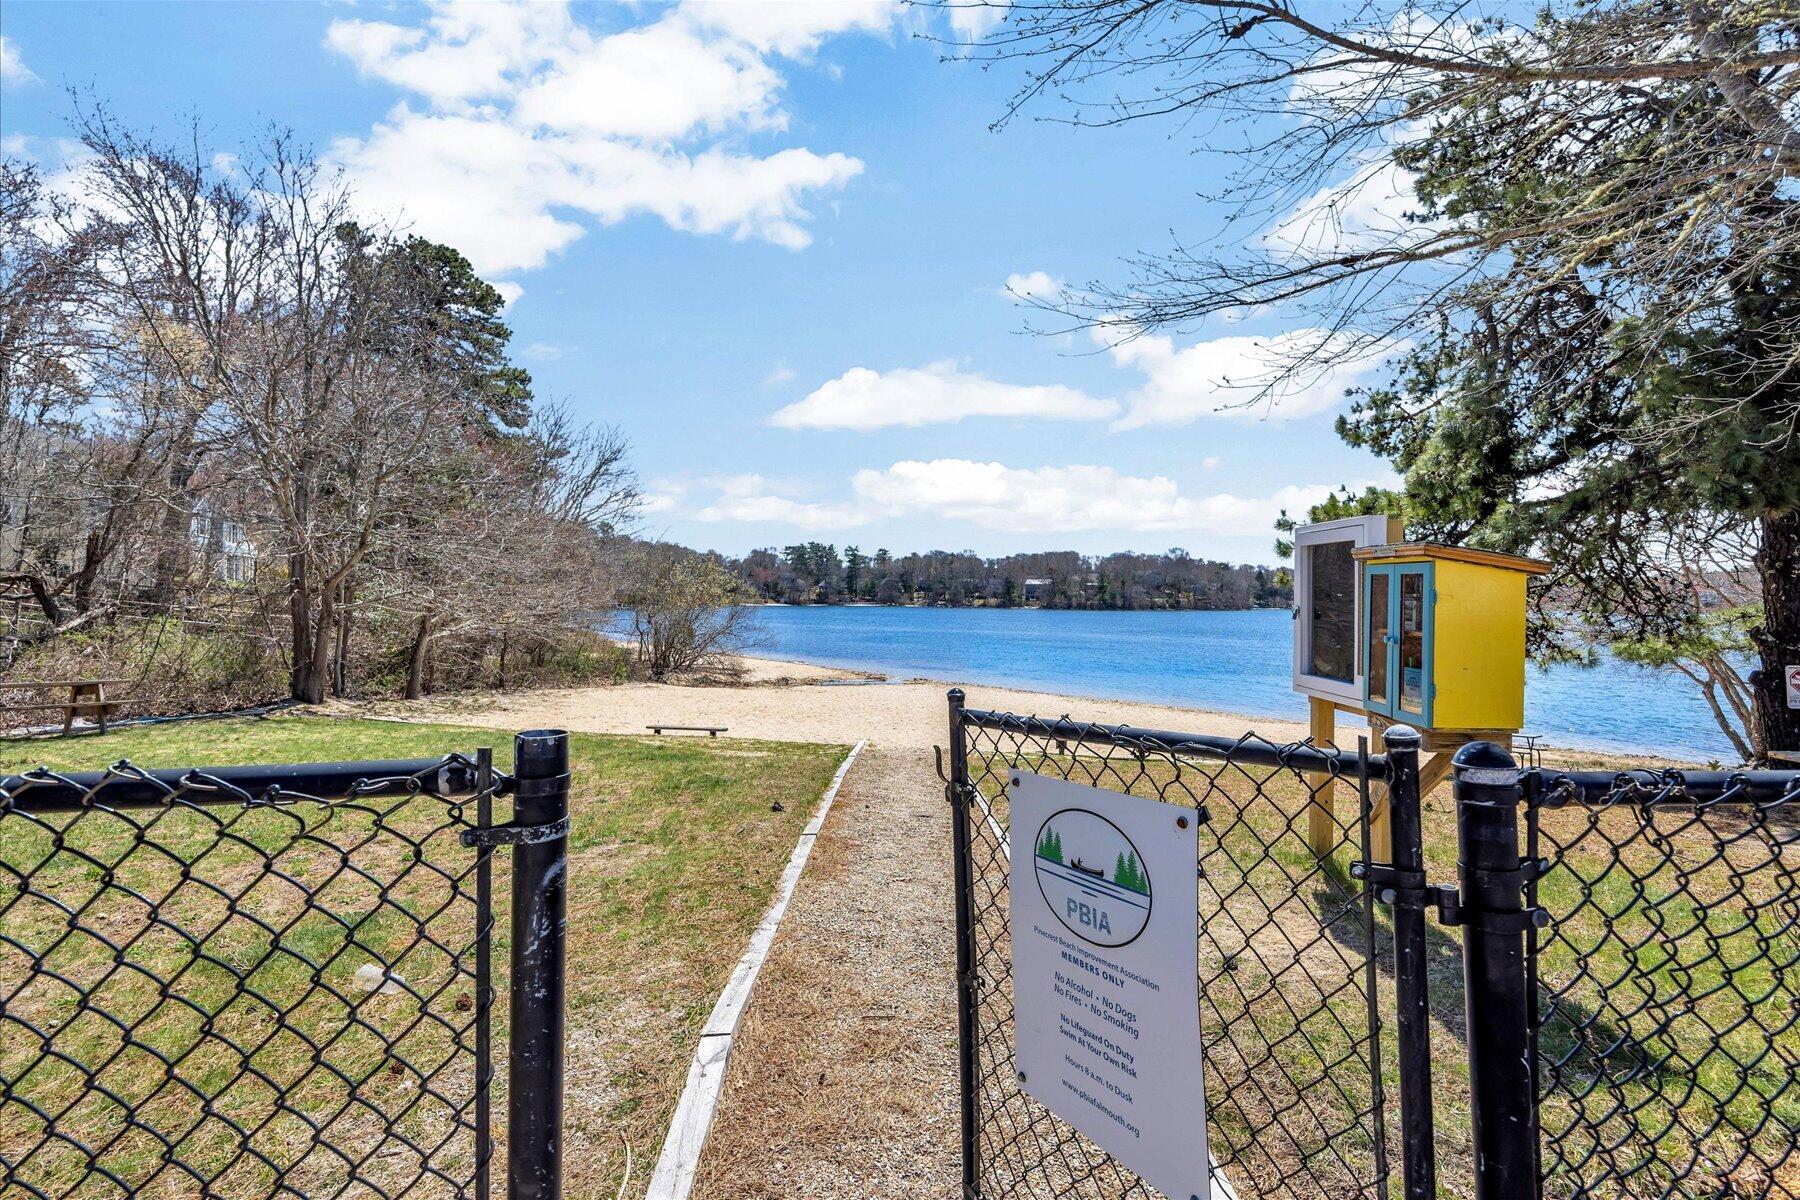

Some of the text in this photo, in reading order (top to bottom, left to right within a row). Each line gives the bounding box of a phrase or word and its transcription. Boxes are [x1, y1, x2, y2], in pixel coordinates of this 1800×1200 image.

[1066, 897, 1112, 936] PBIA
[1033, 925, 1160, 992] Pinecrest Beach Improvement Association
[1061, 950, 1125, 988] MEMBERS ONLY
[1054, 971, 1137, 1022] No Alcohol No Dogs
[1054, 983, 1139, 1039] No Fires No Smoking
[1060, 1013, 1135, 1064] No Lifeguard On Duty
[1060, 1025, 1138, 1079] Swim At Your Own Risk
[1065, 1054, 1134, 1104] Hours 8 a.m. to Dusk
[1061, 1078, 1141, 1138] www.pbiafalmouth.org
